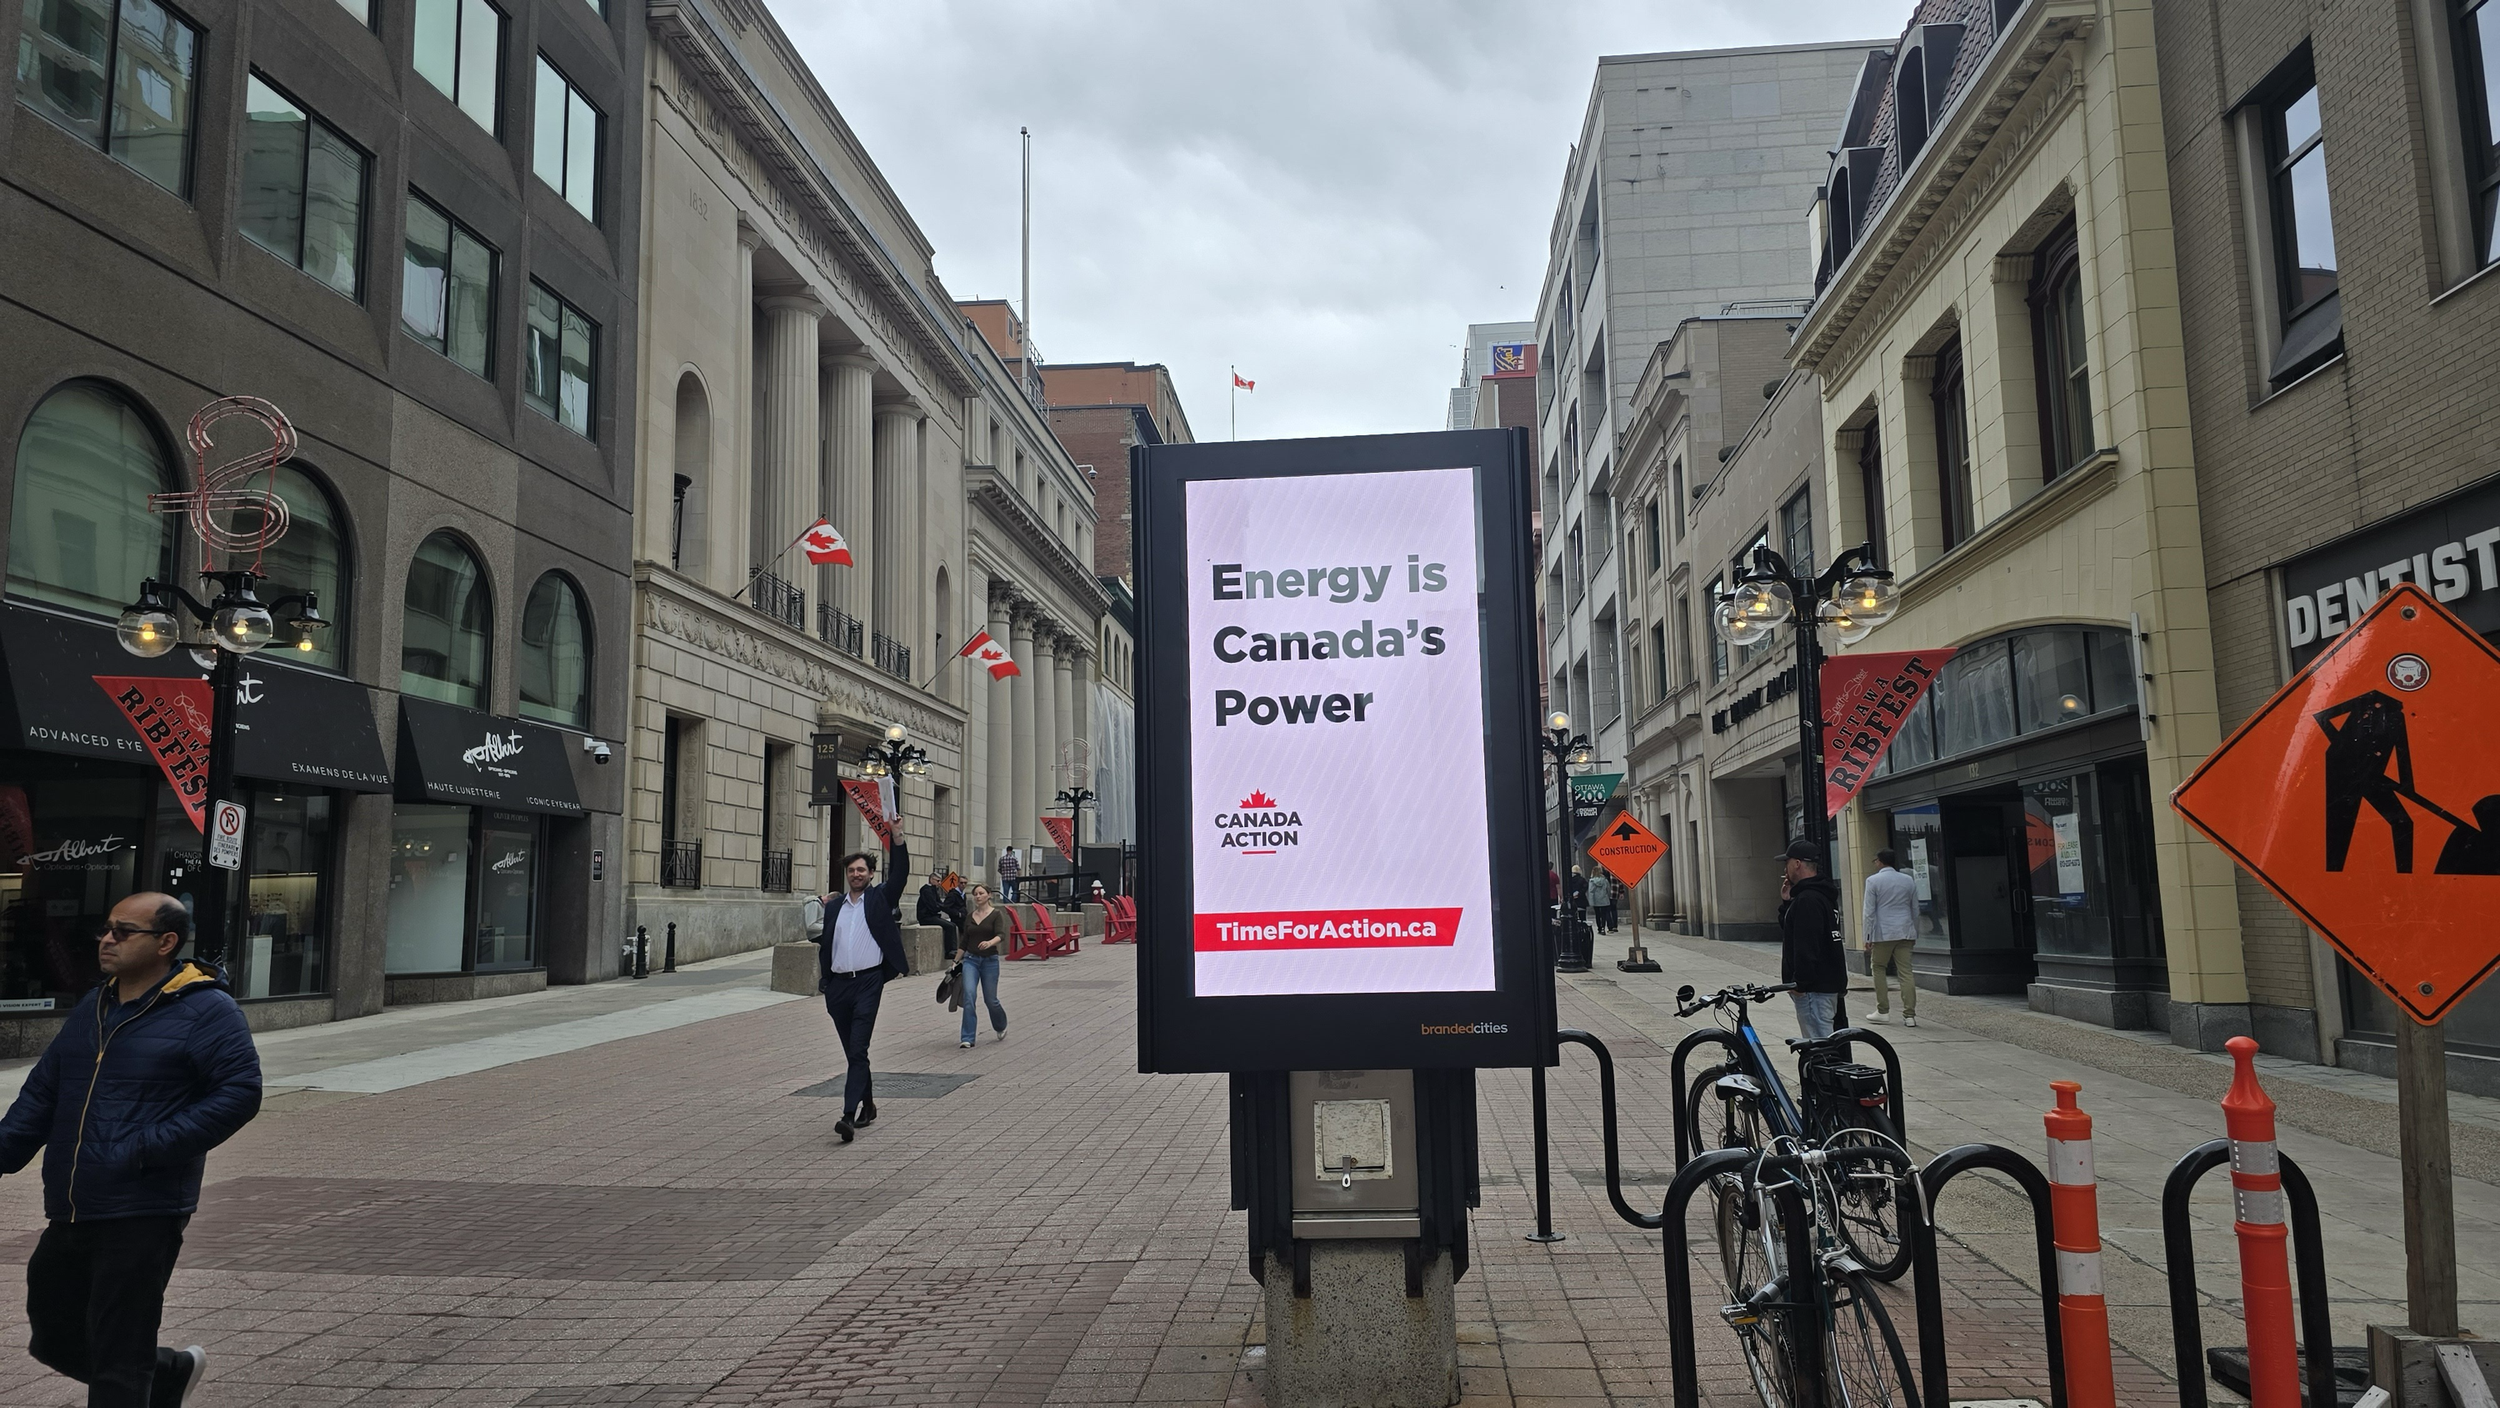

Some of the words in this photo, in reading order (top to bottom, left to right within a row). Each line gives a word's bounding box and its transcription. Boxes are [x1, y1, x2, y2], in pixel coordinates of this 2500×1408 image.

[689, 188, 708, 222] 1832
[766, 176, 791, 226] THE
[798, 214, 828, 265] BANK
[832, 258, 848, 286] OF
[851, 280, 878, 320] NOVA
[880, 312, 912, 364] SCOTIA
[1212, 563, 1392, 604] Energy
[1407, 554, 1448, 593] is
[1213, 619, 1446, 663] Canada’s
[1215, 689, 1374, 727] Power
[1832, 676, 1890, 750] OTTAWA
[153, 697, 210, 766] OTTAWA
[1828, 656, 1933, 793] RIBFEST
[30, 726, 110, 747] ADVANCED
[117, 739, 143, 751] EYE
[817, 744, 835, 754] 125
[292, 763, 339, 778] EXAMENS
[342, 770, 354, 780] DE
[356, 772, 368, 782] LA
[370, 774, 388, 784] VUE
[1968, 762, 1980, 779] 132
[427, 782, 454, 793] HAUTE
[456, 786, 501, 799] LUNETTERIE
[526, 797, 550, 807] ICONIC
[551, 800, 581, 810] EYEWEAR
[849, 785, 890, 838] RIBFEST
[1214, 811, 1303, 829] CANADA
[46, 834, 124, 862] Albert
[1045, 819, 1071, 855] RIBFEST
[1221, 830, 1298, 848] ACTION
[1599, 844, 1658, 857] CONSTRUCTION
[1216, 918, 1437, 942] TimeForAction.ca
[1421, 1021, 1508, 1035] brandedcities
